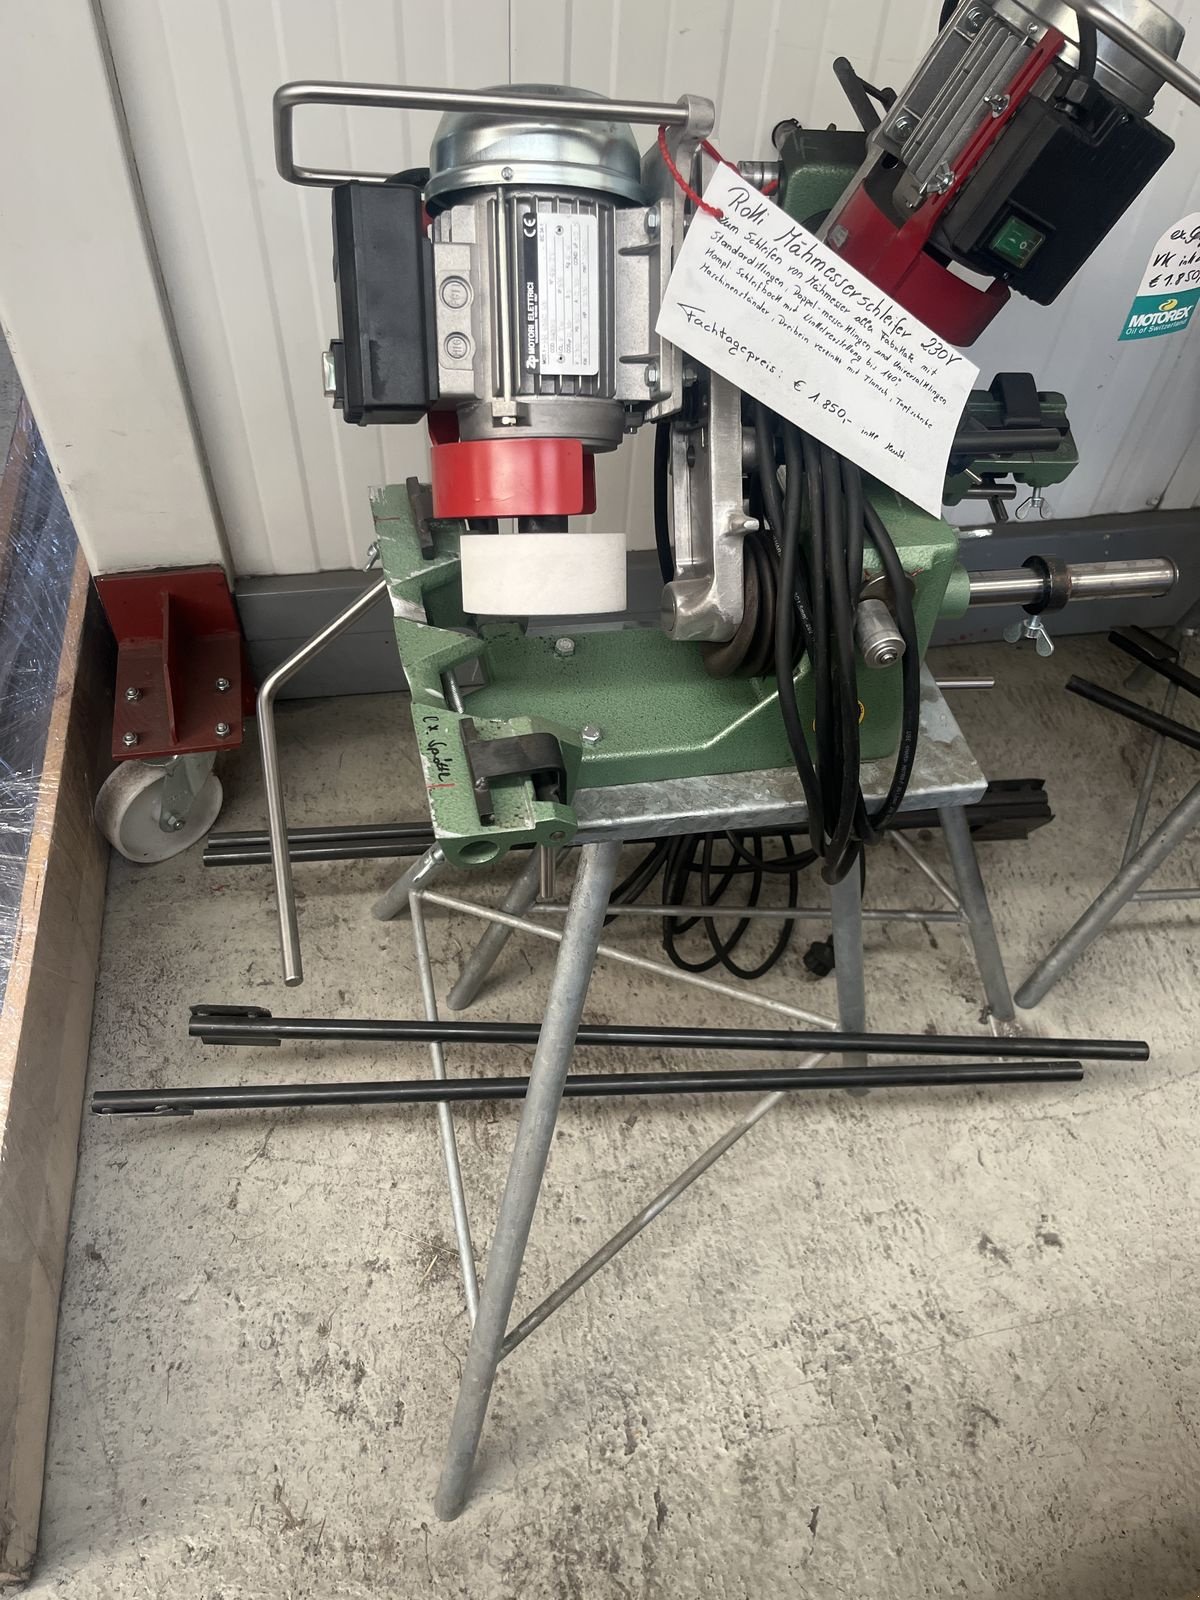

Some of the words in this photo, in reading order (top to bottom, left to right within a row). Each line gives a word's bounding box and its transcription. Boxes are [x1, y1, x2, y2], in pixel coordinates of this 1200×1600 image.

[1149, 274, 1162, 288] €
[527, 281, 535, 321] ELETTRICI
[743, 231, 783, 265] Schleifen
[786, 265, 804, 280] von
[920, 364, 938, 377] mit
[1128, 305, 1194, 328] MOTOREX
[782, 302, 800, 313] mit
[865, 357, 878, 371] bis
[1126, 327, 1137, 335] Oil
[1139, 326, 1147, 334] of
[1148, 319, 1188, 332] Switzerland
[527, 324, 535, 354] MOTORI
[873, 349, 893, 361] und
[846, 362, 861, 375] mit
[793, 379, 807, 393] €
